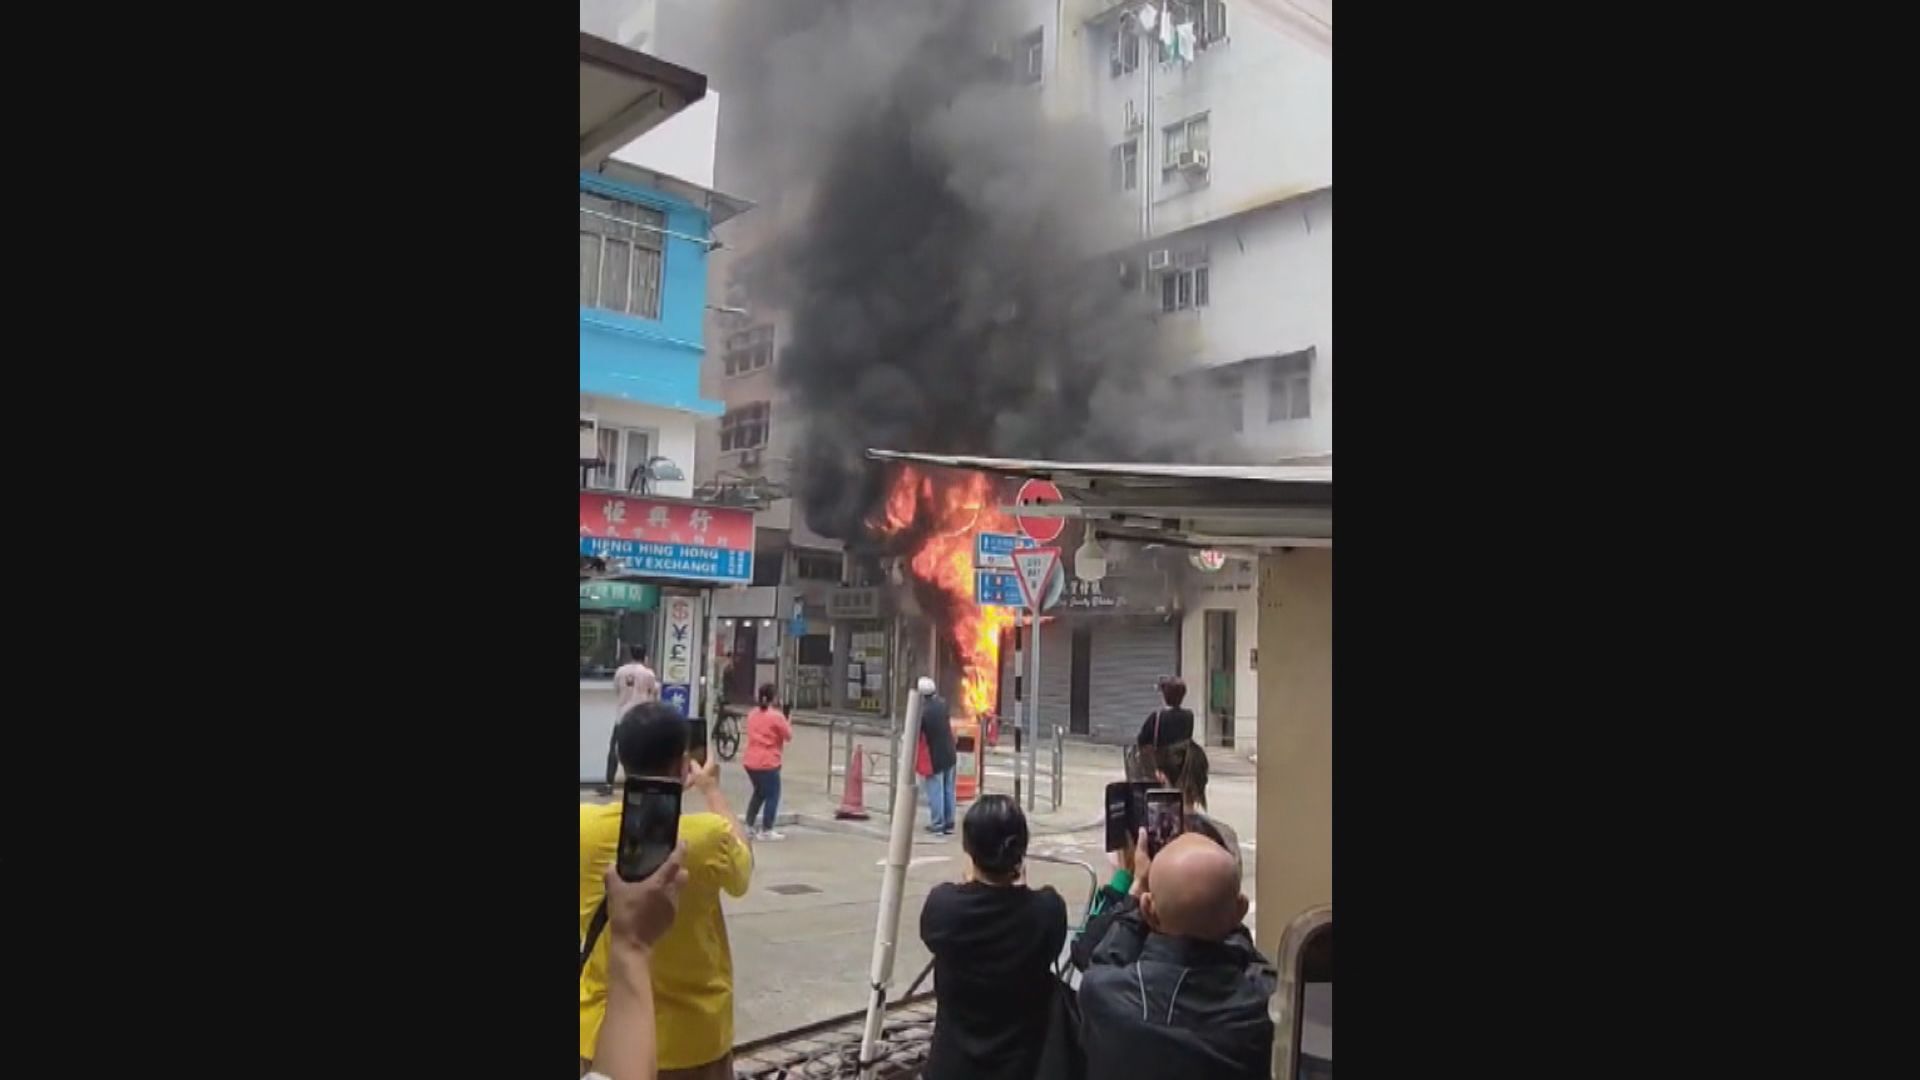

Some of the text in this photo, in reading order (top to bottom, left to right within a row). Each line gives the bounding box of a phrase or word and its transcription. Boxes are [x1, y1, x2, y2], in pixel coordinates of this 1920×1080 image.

[592, 537, 719, 560] HENG HING HONG
[645, 557, 719, 573] EXCHANGE
